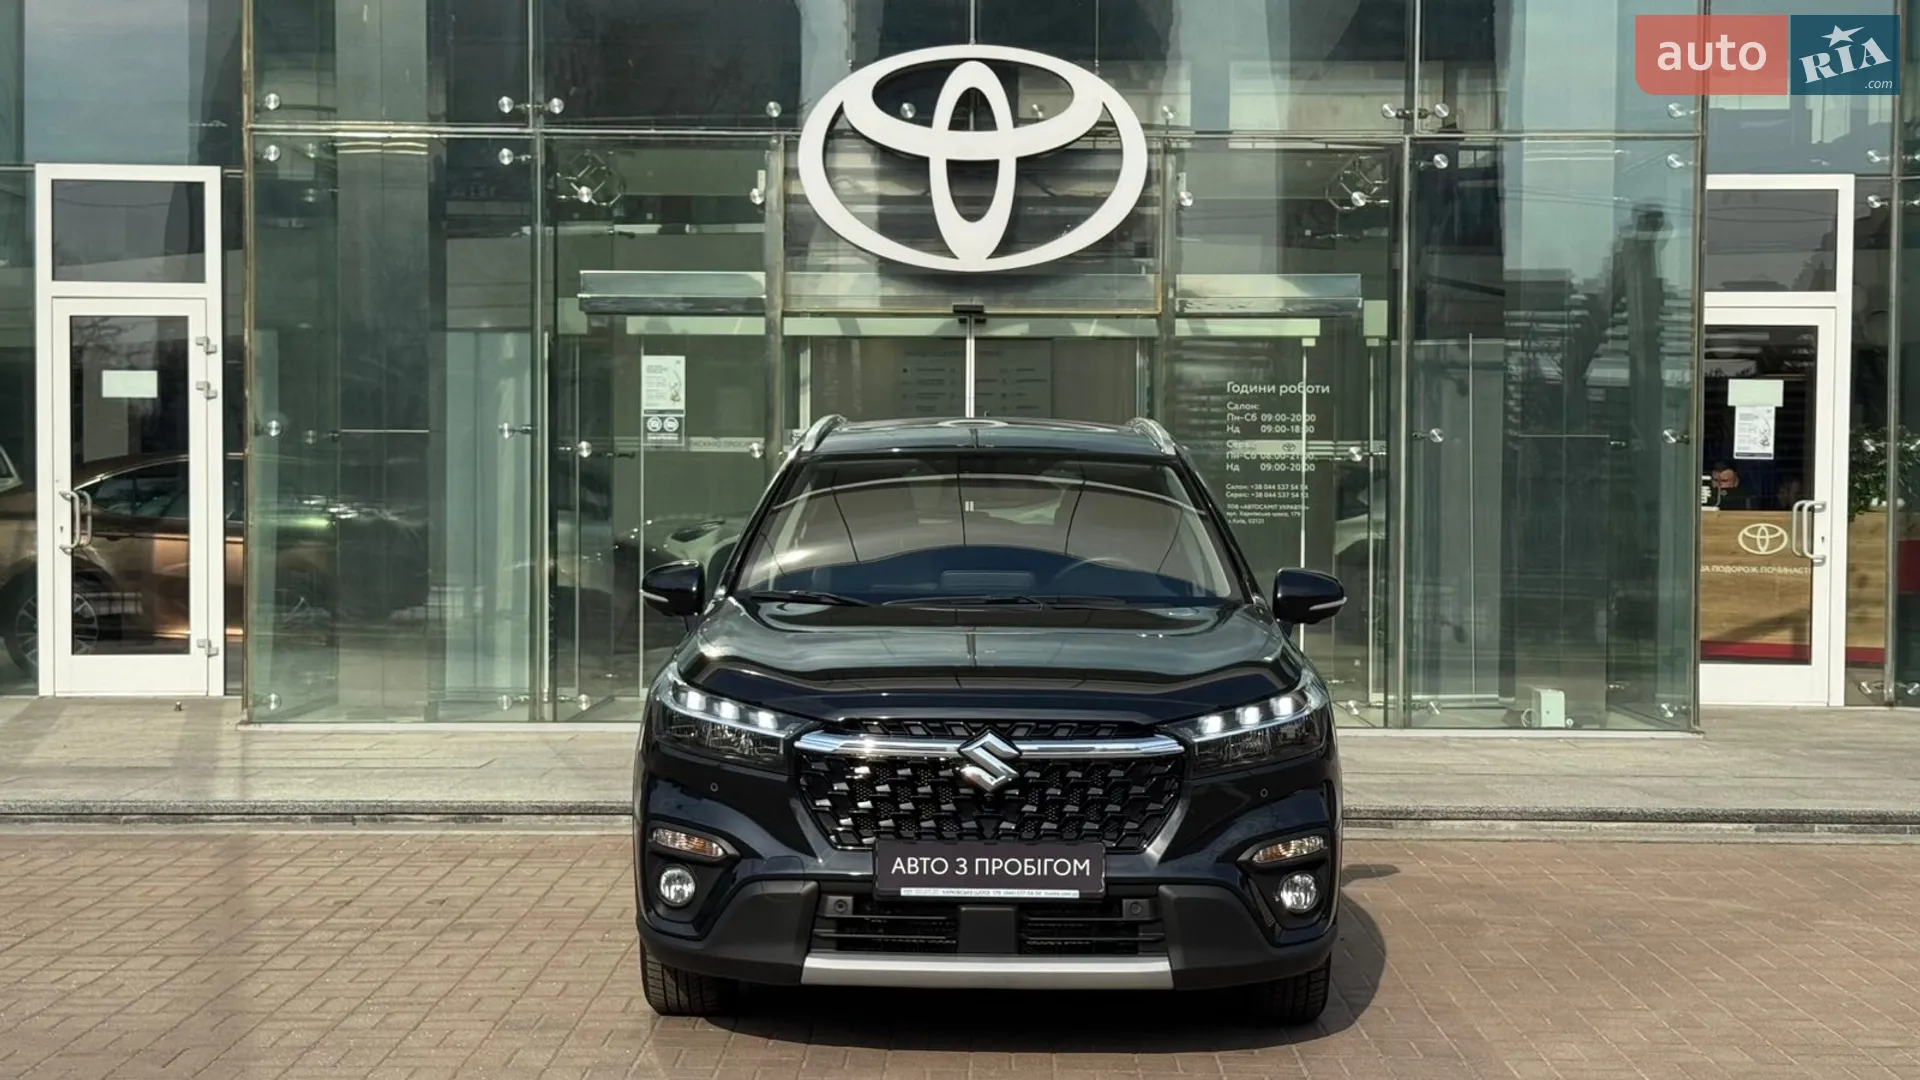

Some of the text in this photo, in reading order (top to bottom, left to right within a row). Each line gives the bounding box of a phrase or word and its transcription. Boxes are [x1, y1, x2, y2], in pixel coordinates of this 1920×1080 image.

[1226, 381, 1330, 396] Години роботи
[1226, 402, 1260, 411] Салон:
[1226, 413, 1257, 422] Пн-Сб
[1226, 425, 1240, 434] Нд
[1226, 463, 1240, 472] Нд
[891, 857, 1090, 876] АВТО З ПРОБІГОМ
